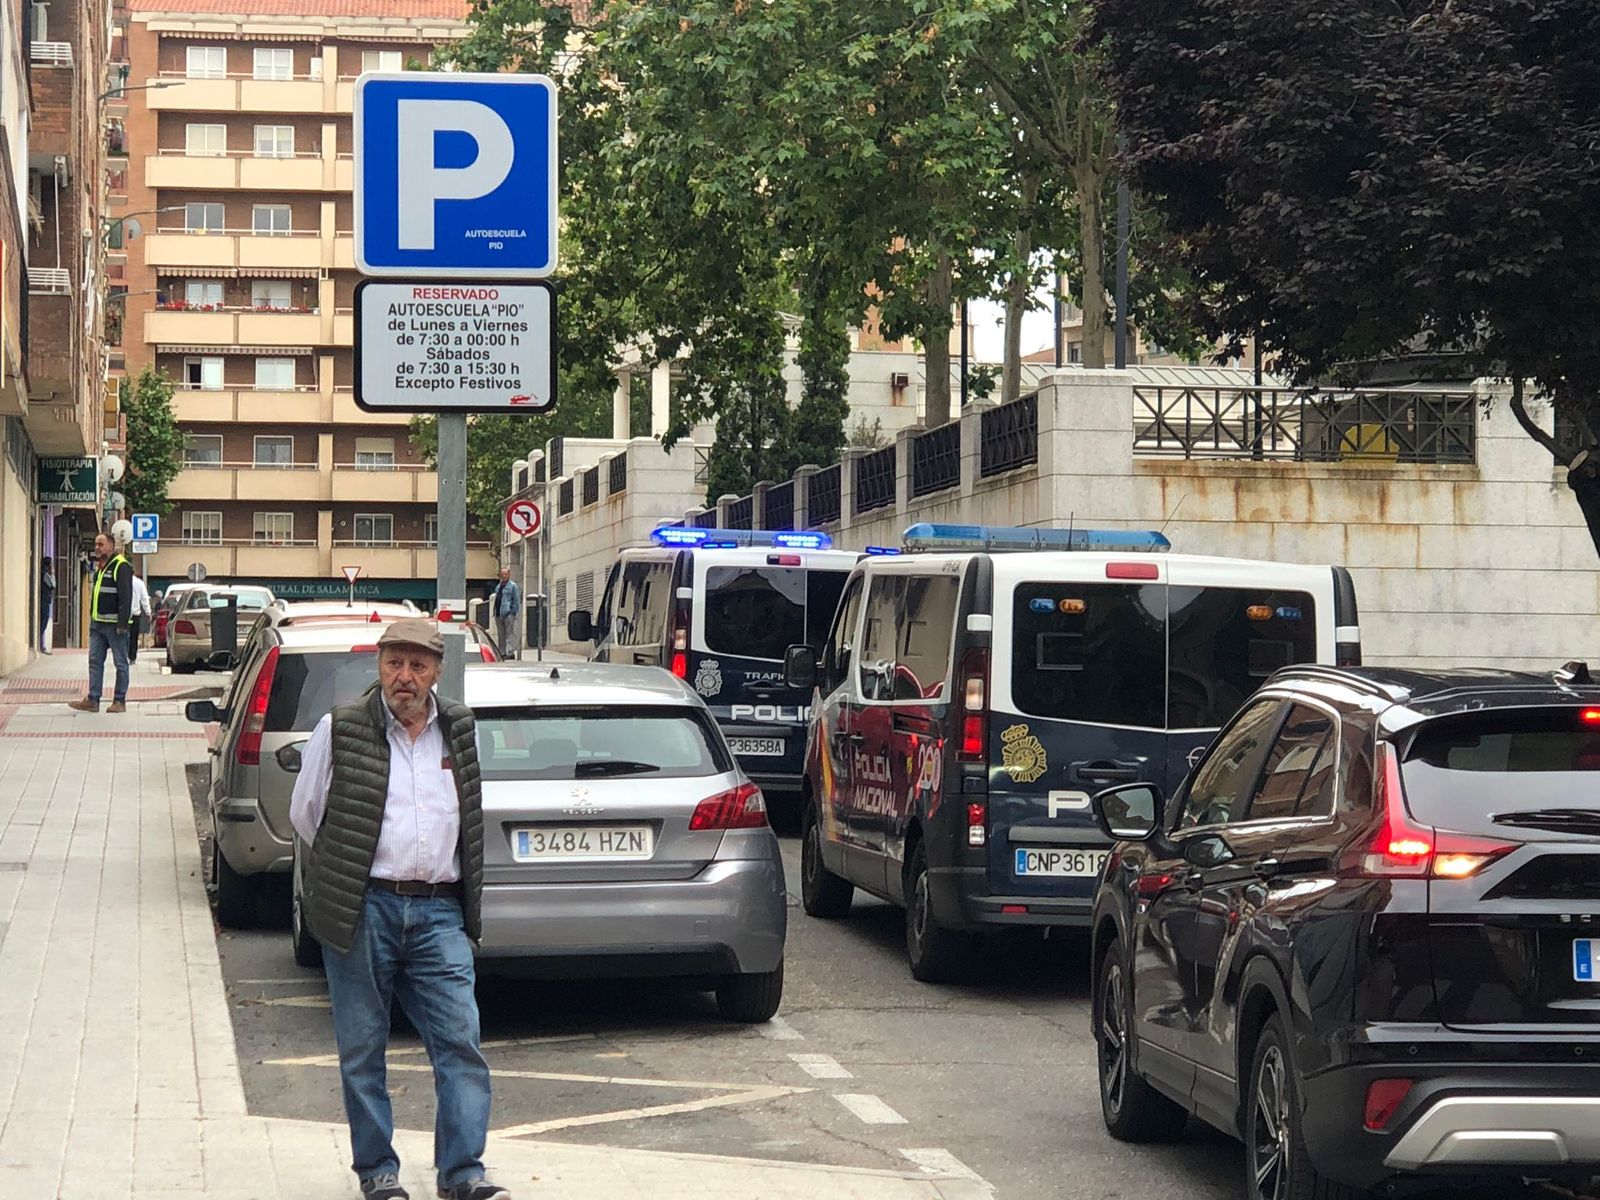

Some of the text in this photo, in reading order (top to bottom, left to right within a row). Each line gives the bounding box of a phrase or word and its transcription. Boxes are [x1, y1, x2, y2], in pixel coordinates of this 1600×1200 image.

[398, 99, 514, 250] P
[465, 229, 527, 238] AUTOESCUELA
[488, 241, 504, 250] PIO
[413, 288, 499, 300] RESERVADO
[388, 303, 490, 317] AUTOESCUELA
[388, 319, 528, 332] de Lunes a Viernes
[396, 333, 519, 346] de 7:30 a 00:00 h
[426, 347, 490, 360] Sábados
[396, 362, 519, 375] de 7:30 a 15:30 h
[395, 376, 521, 391] Excepto Festivos
[41, 458, 93, 469] FISIOTERAPIA
[40, 490, 95, 501] REHABILITACIÓN
[137, 517, 153, 537] P
[302, 585, 315, 594] DE
[316, 585, 379, 594] SALAMANCA
[1048, 790, 1090, 818] P
[534, 832, 591, 853] 3484
[600, 831, 642, 852] HZN
